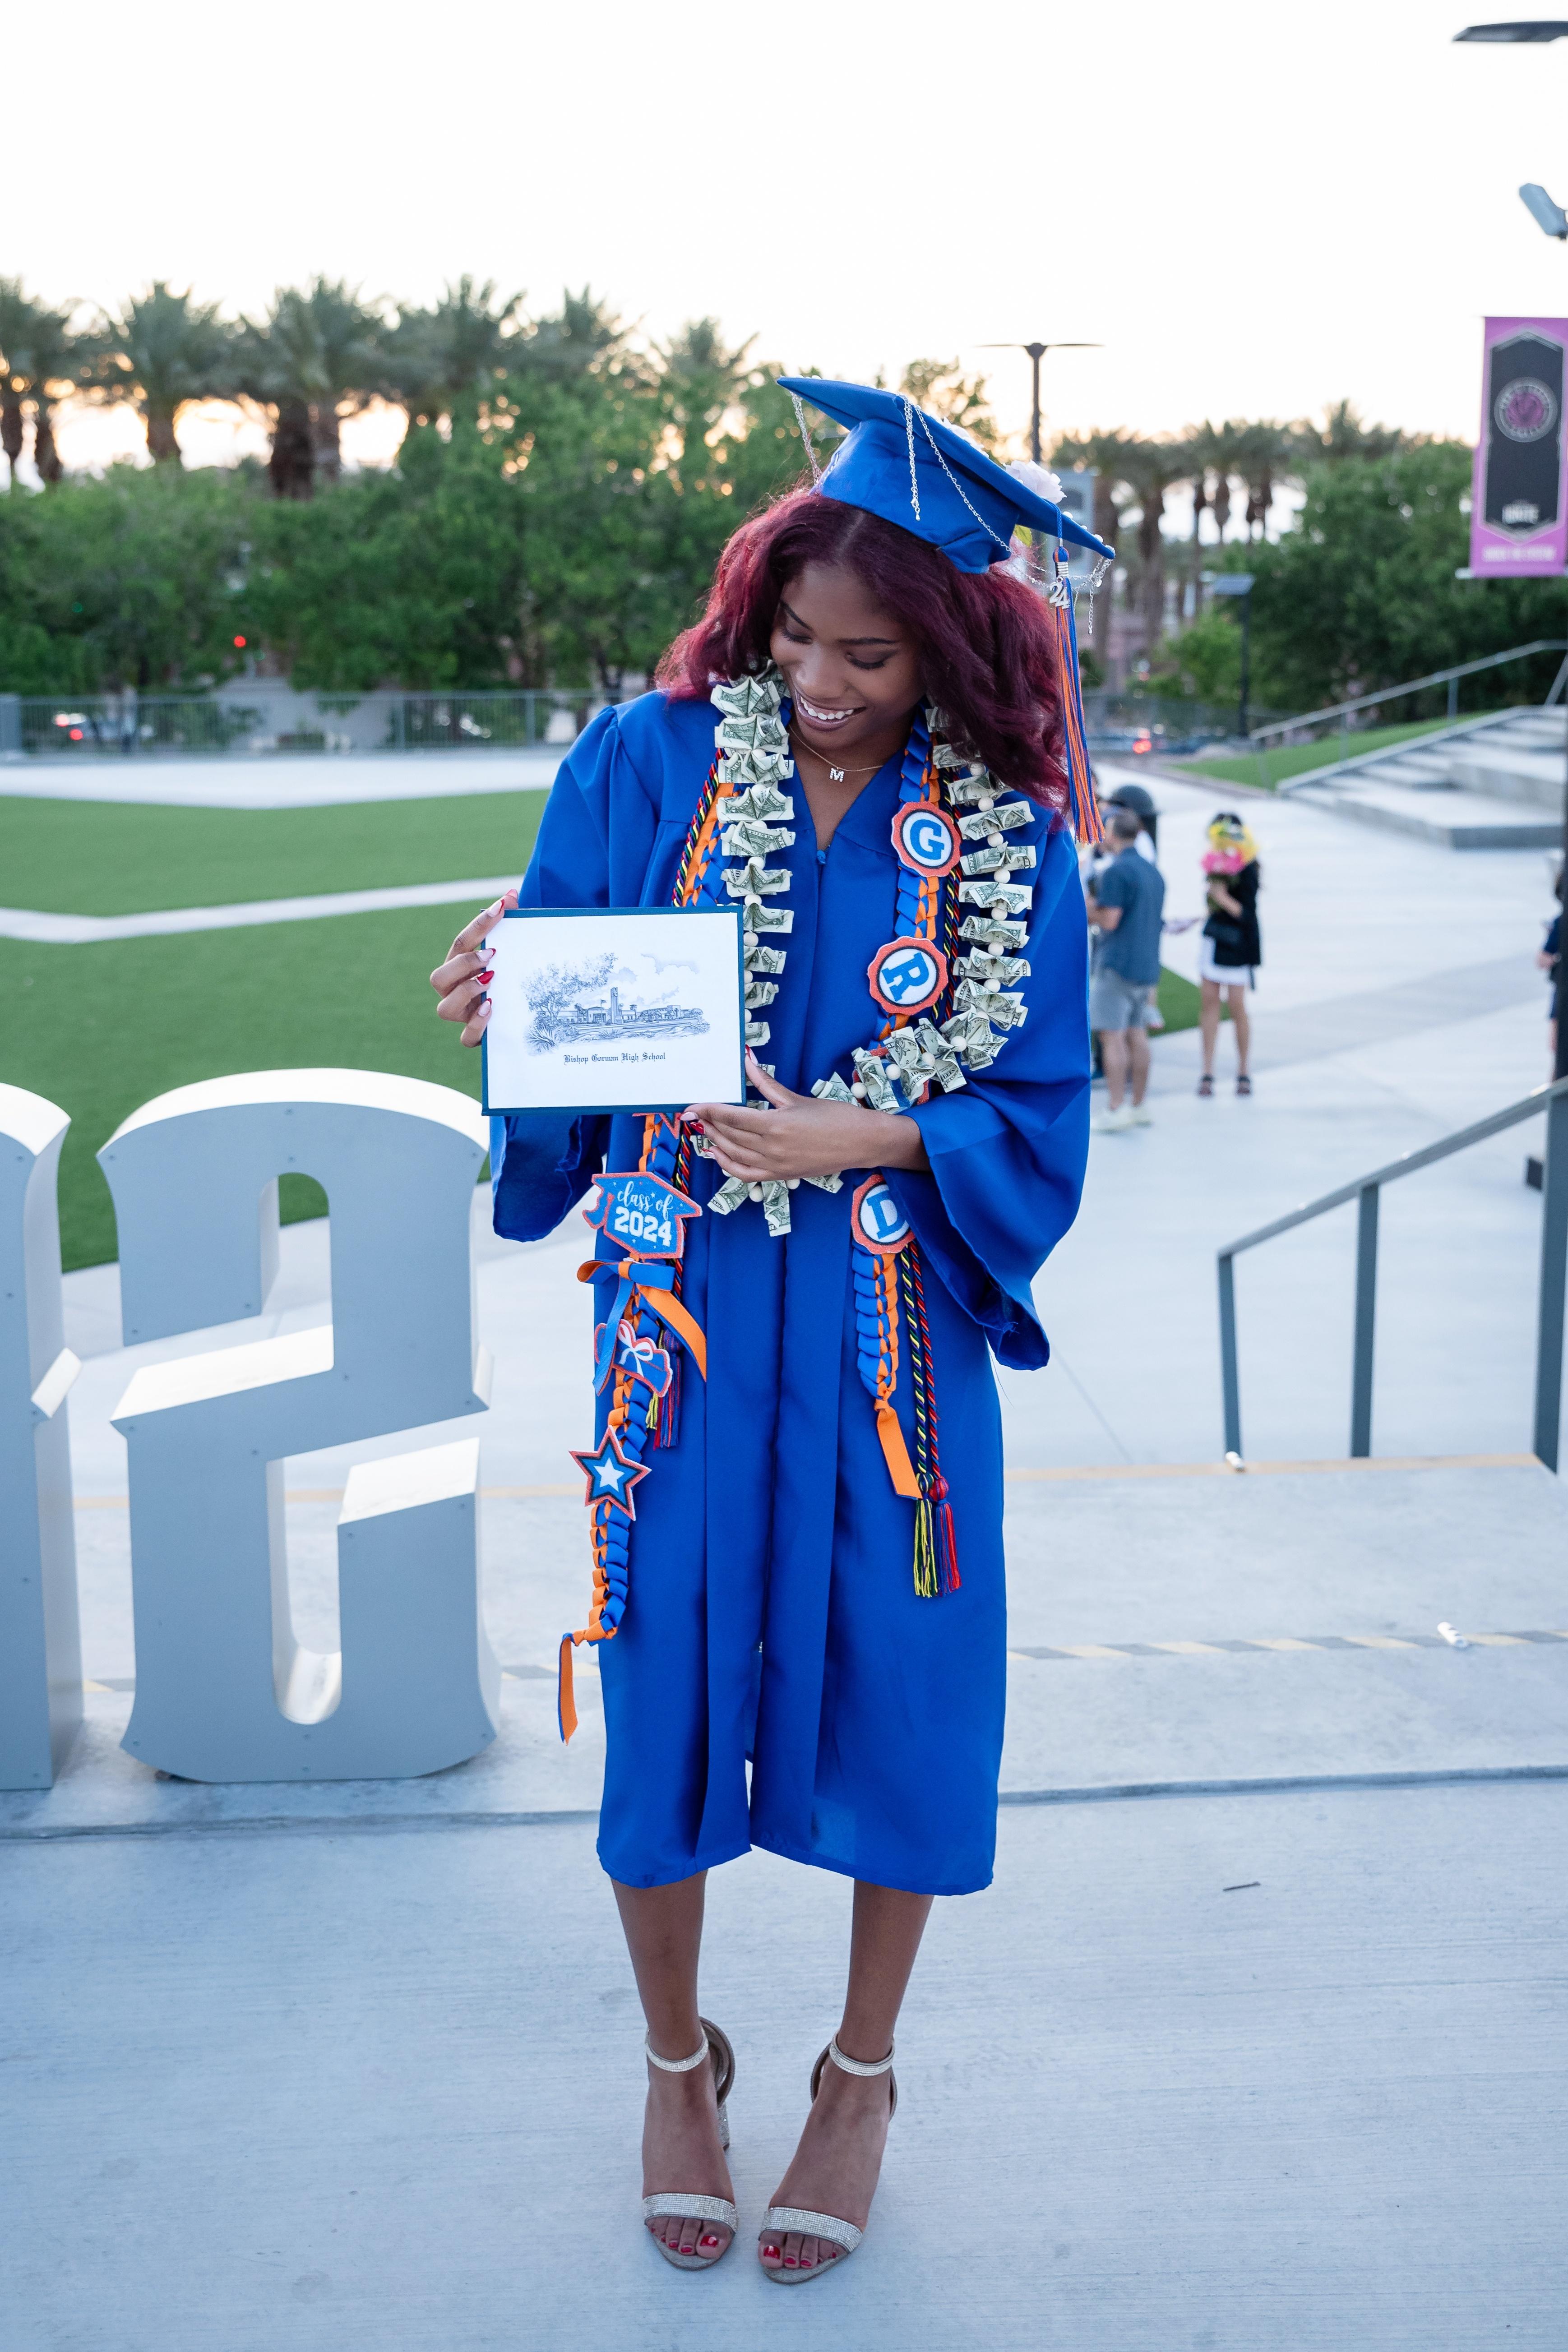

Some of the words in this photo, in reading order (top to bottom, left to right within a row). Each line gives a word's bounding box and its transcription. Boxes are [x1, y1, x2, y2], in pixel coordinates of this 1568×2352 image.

[1049, 582, 1070, 609] 24
[829, 767, 844, 782] M
[910, 819, 945, 860] G
[881, 951, 930, 1001] R
[564, 1054, 588, 1065] Bishop
[591, 1054, 619, 1062] Gorman
[621, 1053, 638, 1063] High
[642, 1052, 666, 1062] School
[617, 1180, 652, 1212] class
[655, 1194, 673, 1220] of
[614, 1206, 671, 1247] 2024
